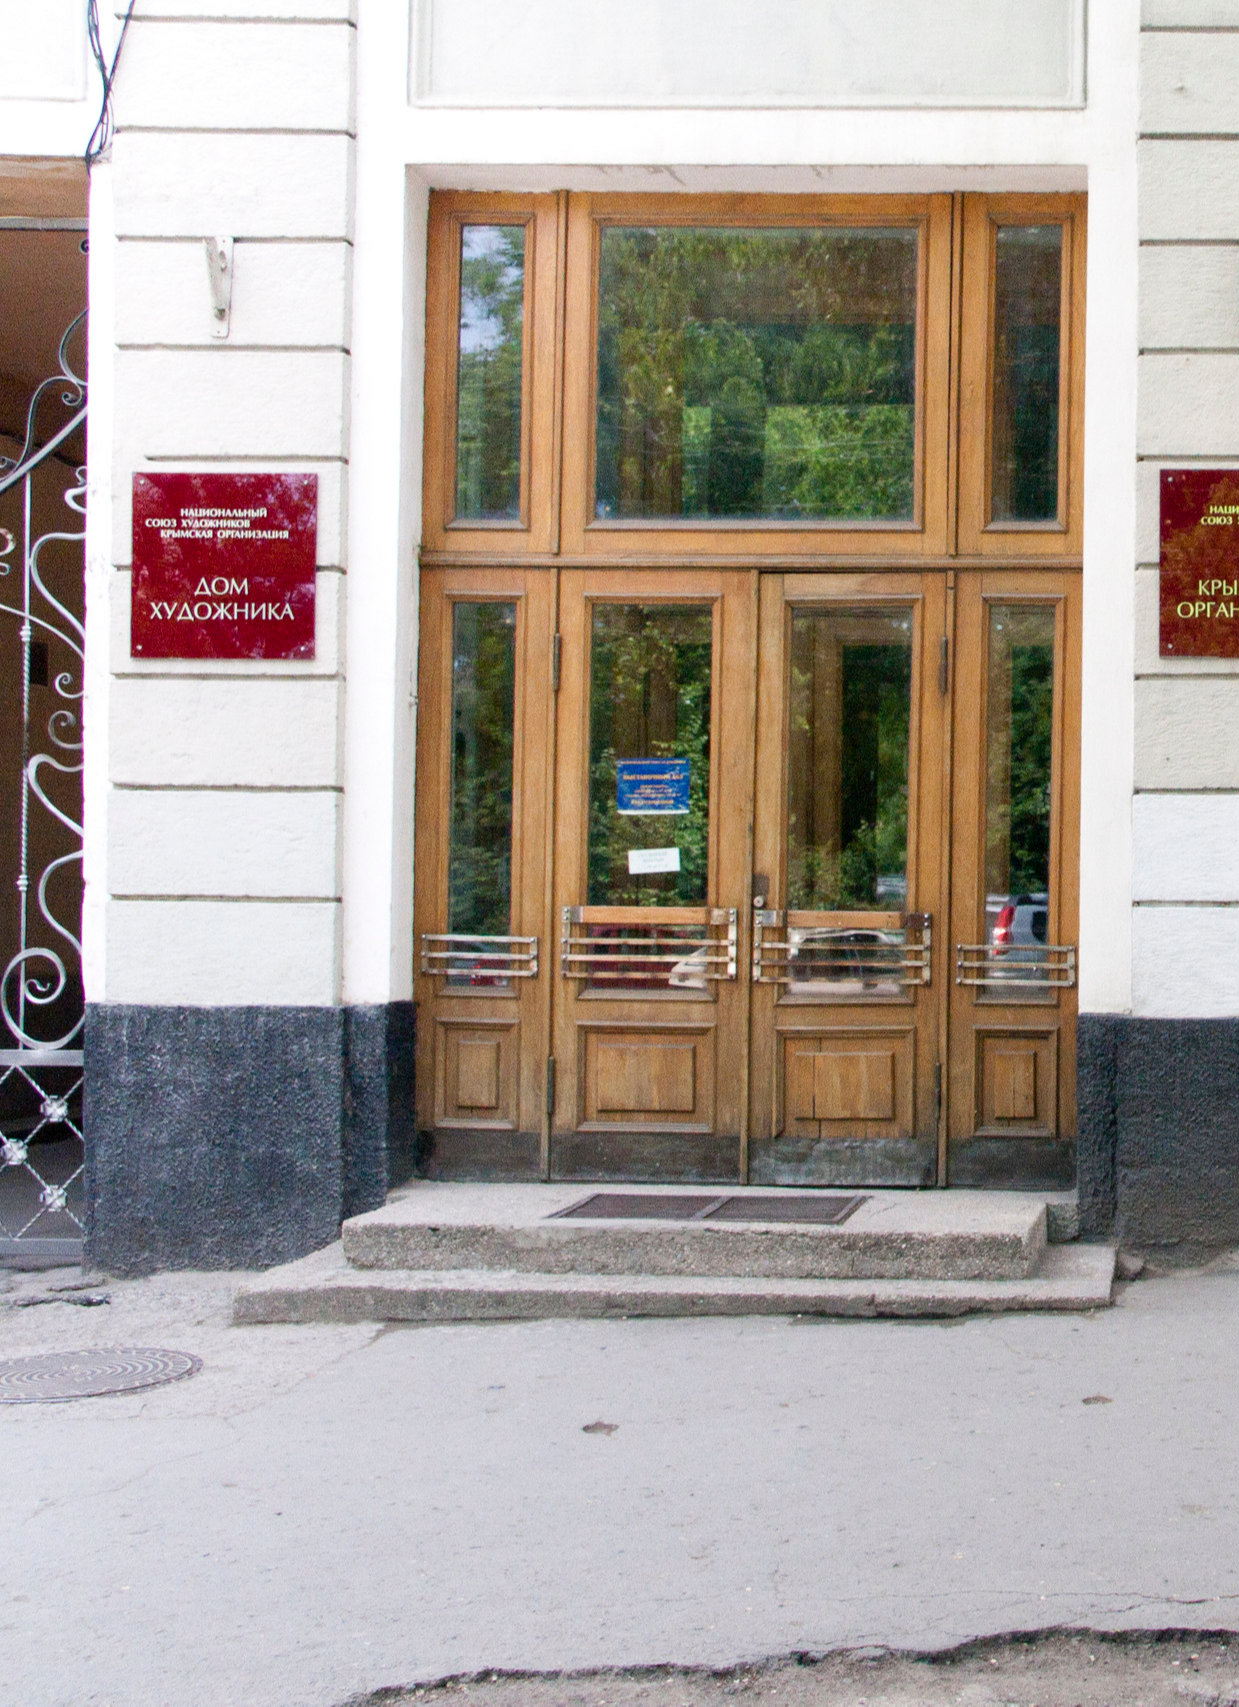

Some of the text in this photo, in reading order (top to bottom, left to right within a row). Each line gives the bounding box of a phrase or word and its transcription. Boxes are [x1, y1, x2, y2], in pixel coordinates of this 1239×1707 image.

[180, 507, 267, 518] НАЦИОНАЛЬНЫЙ
[145, 518, 250, 529] СОЮЗ ХУДОЖНИКОВ
[1200, 516, 1233, 525] СОЮЗ
[160, 529, 289, 540] КРЫМСКАЯ ОРГАНИЗАЦИЯ
[194, 577, 249, 597] ДОМ
[150, 602, 295, 622] ХУДОЖНИКА
